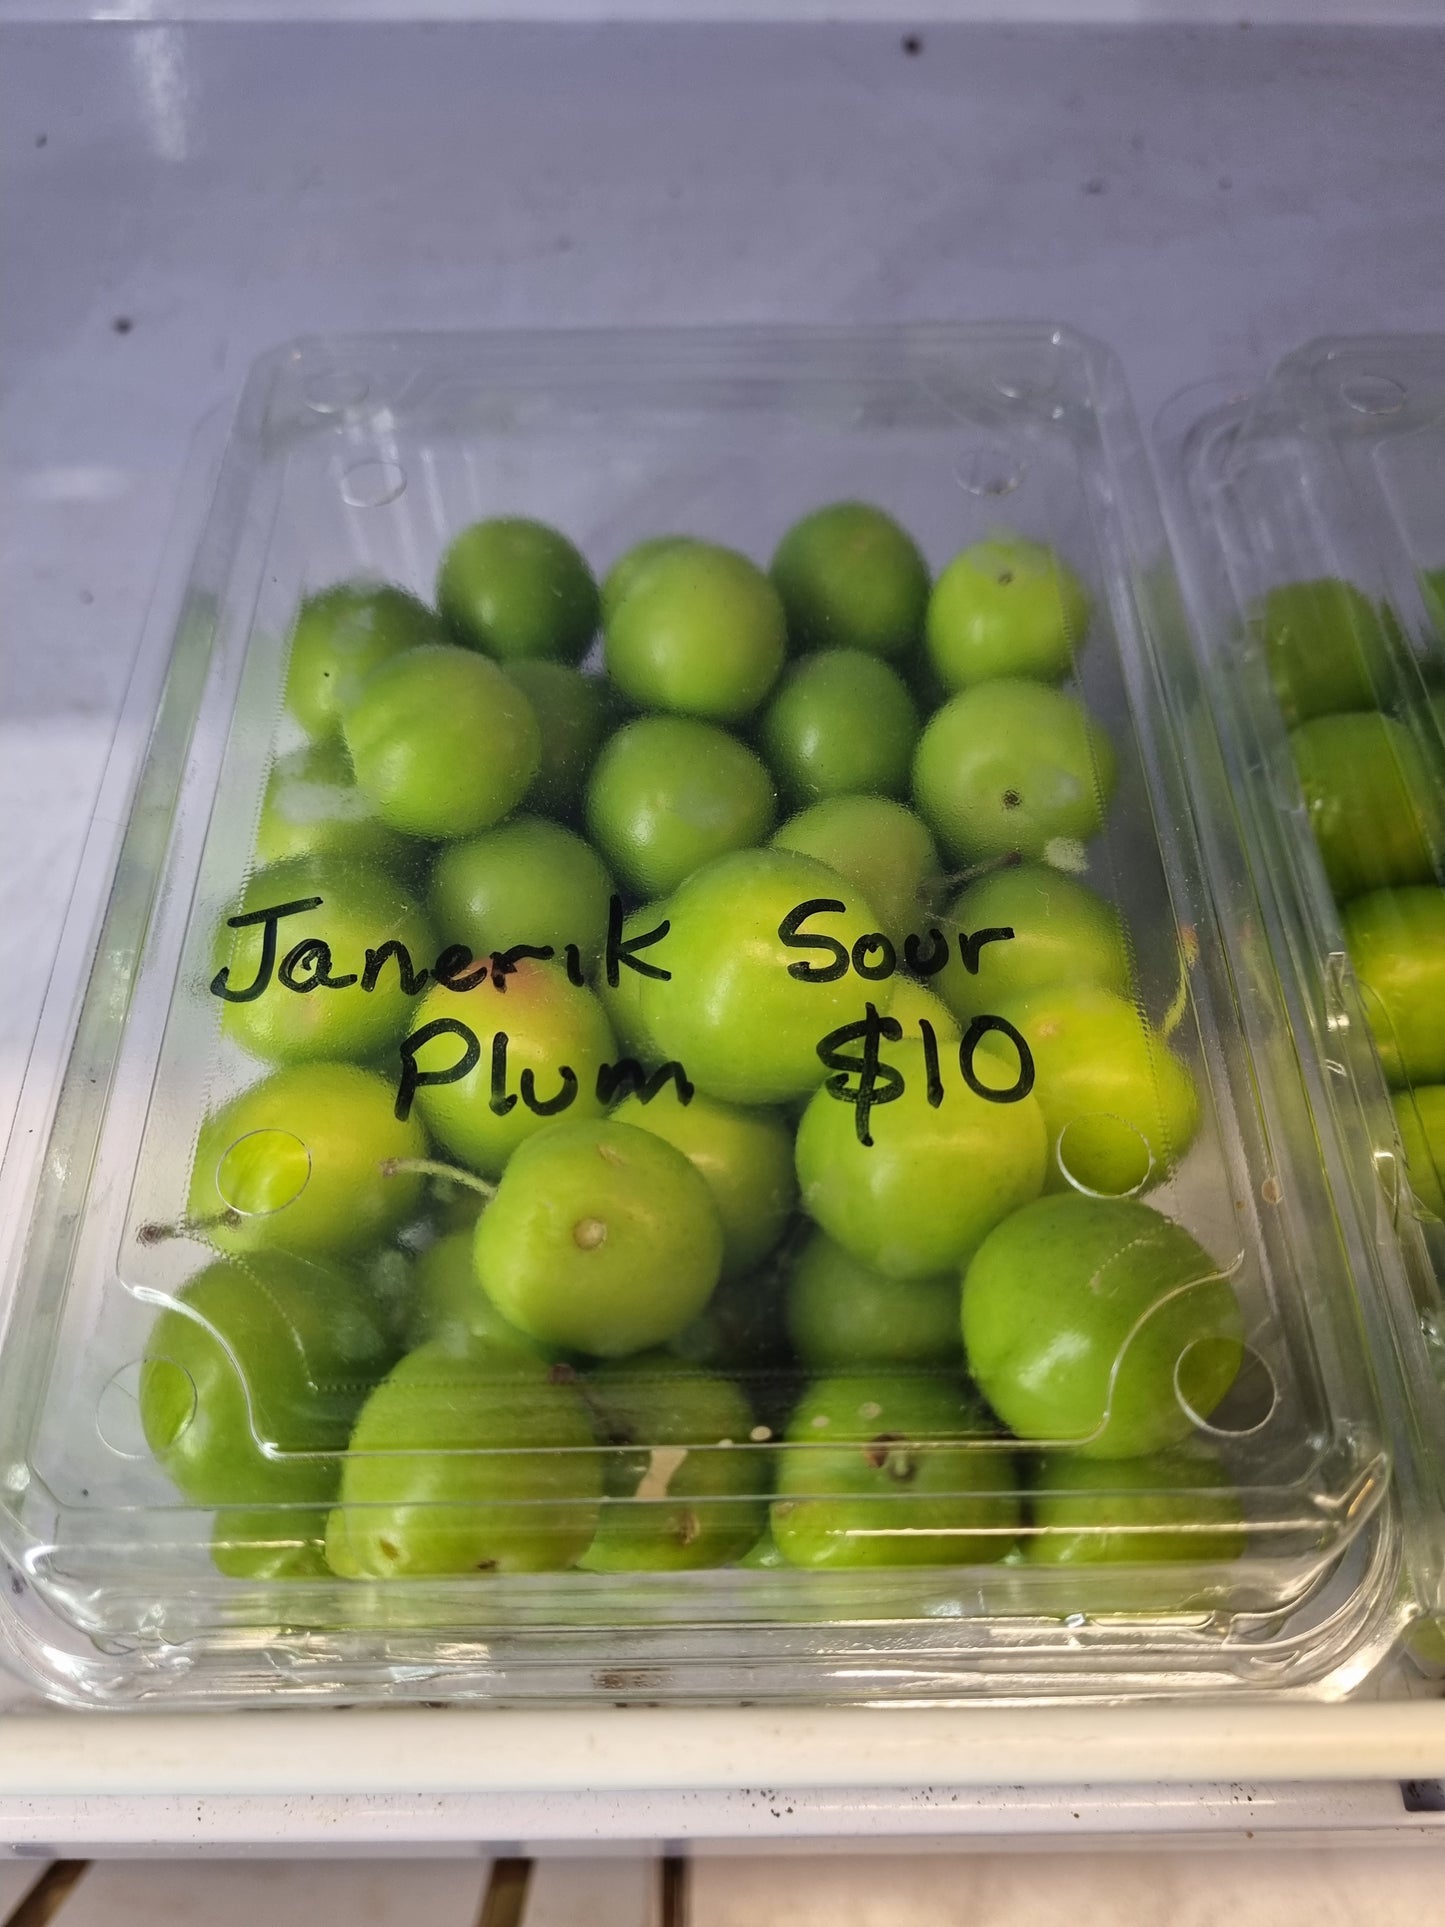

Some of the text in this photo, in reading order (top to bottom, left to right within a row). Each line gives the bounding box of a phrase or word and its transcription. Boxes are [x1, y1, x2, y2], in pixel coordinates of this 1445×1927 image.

[210, 894, 1016, 1003] Janerik Sour
[394, 1002, 1036, 1147] Plum $10
